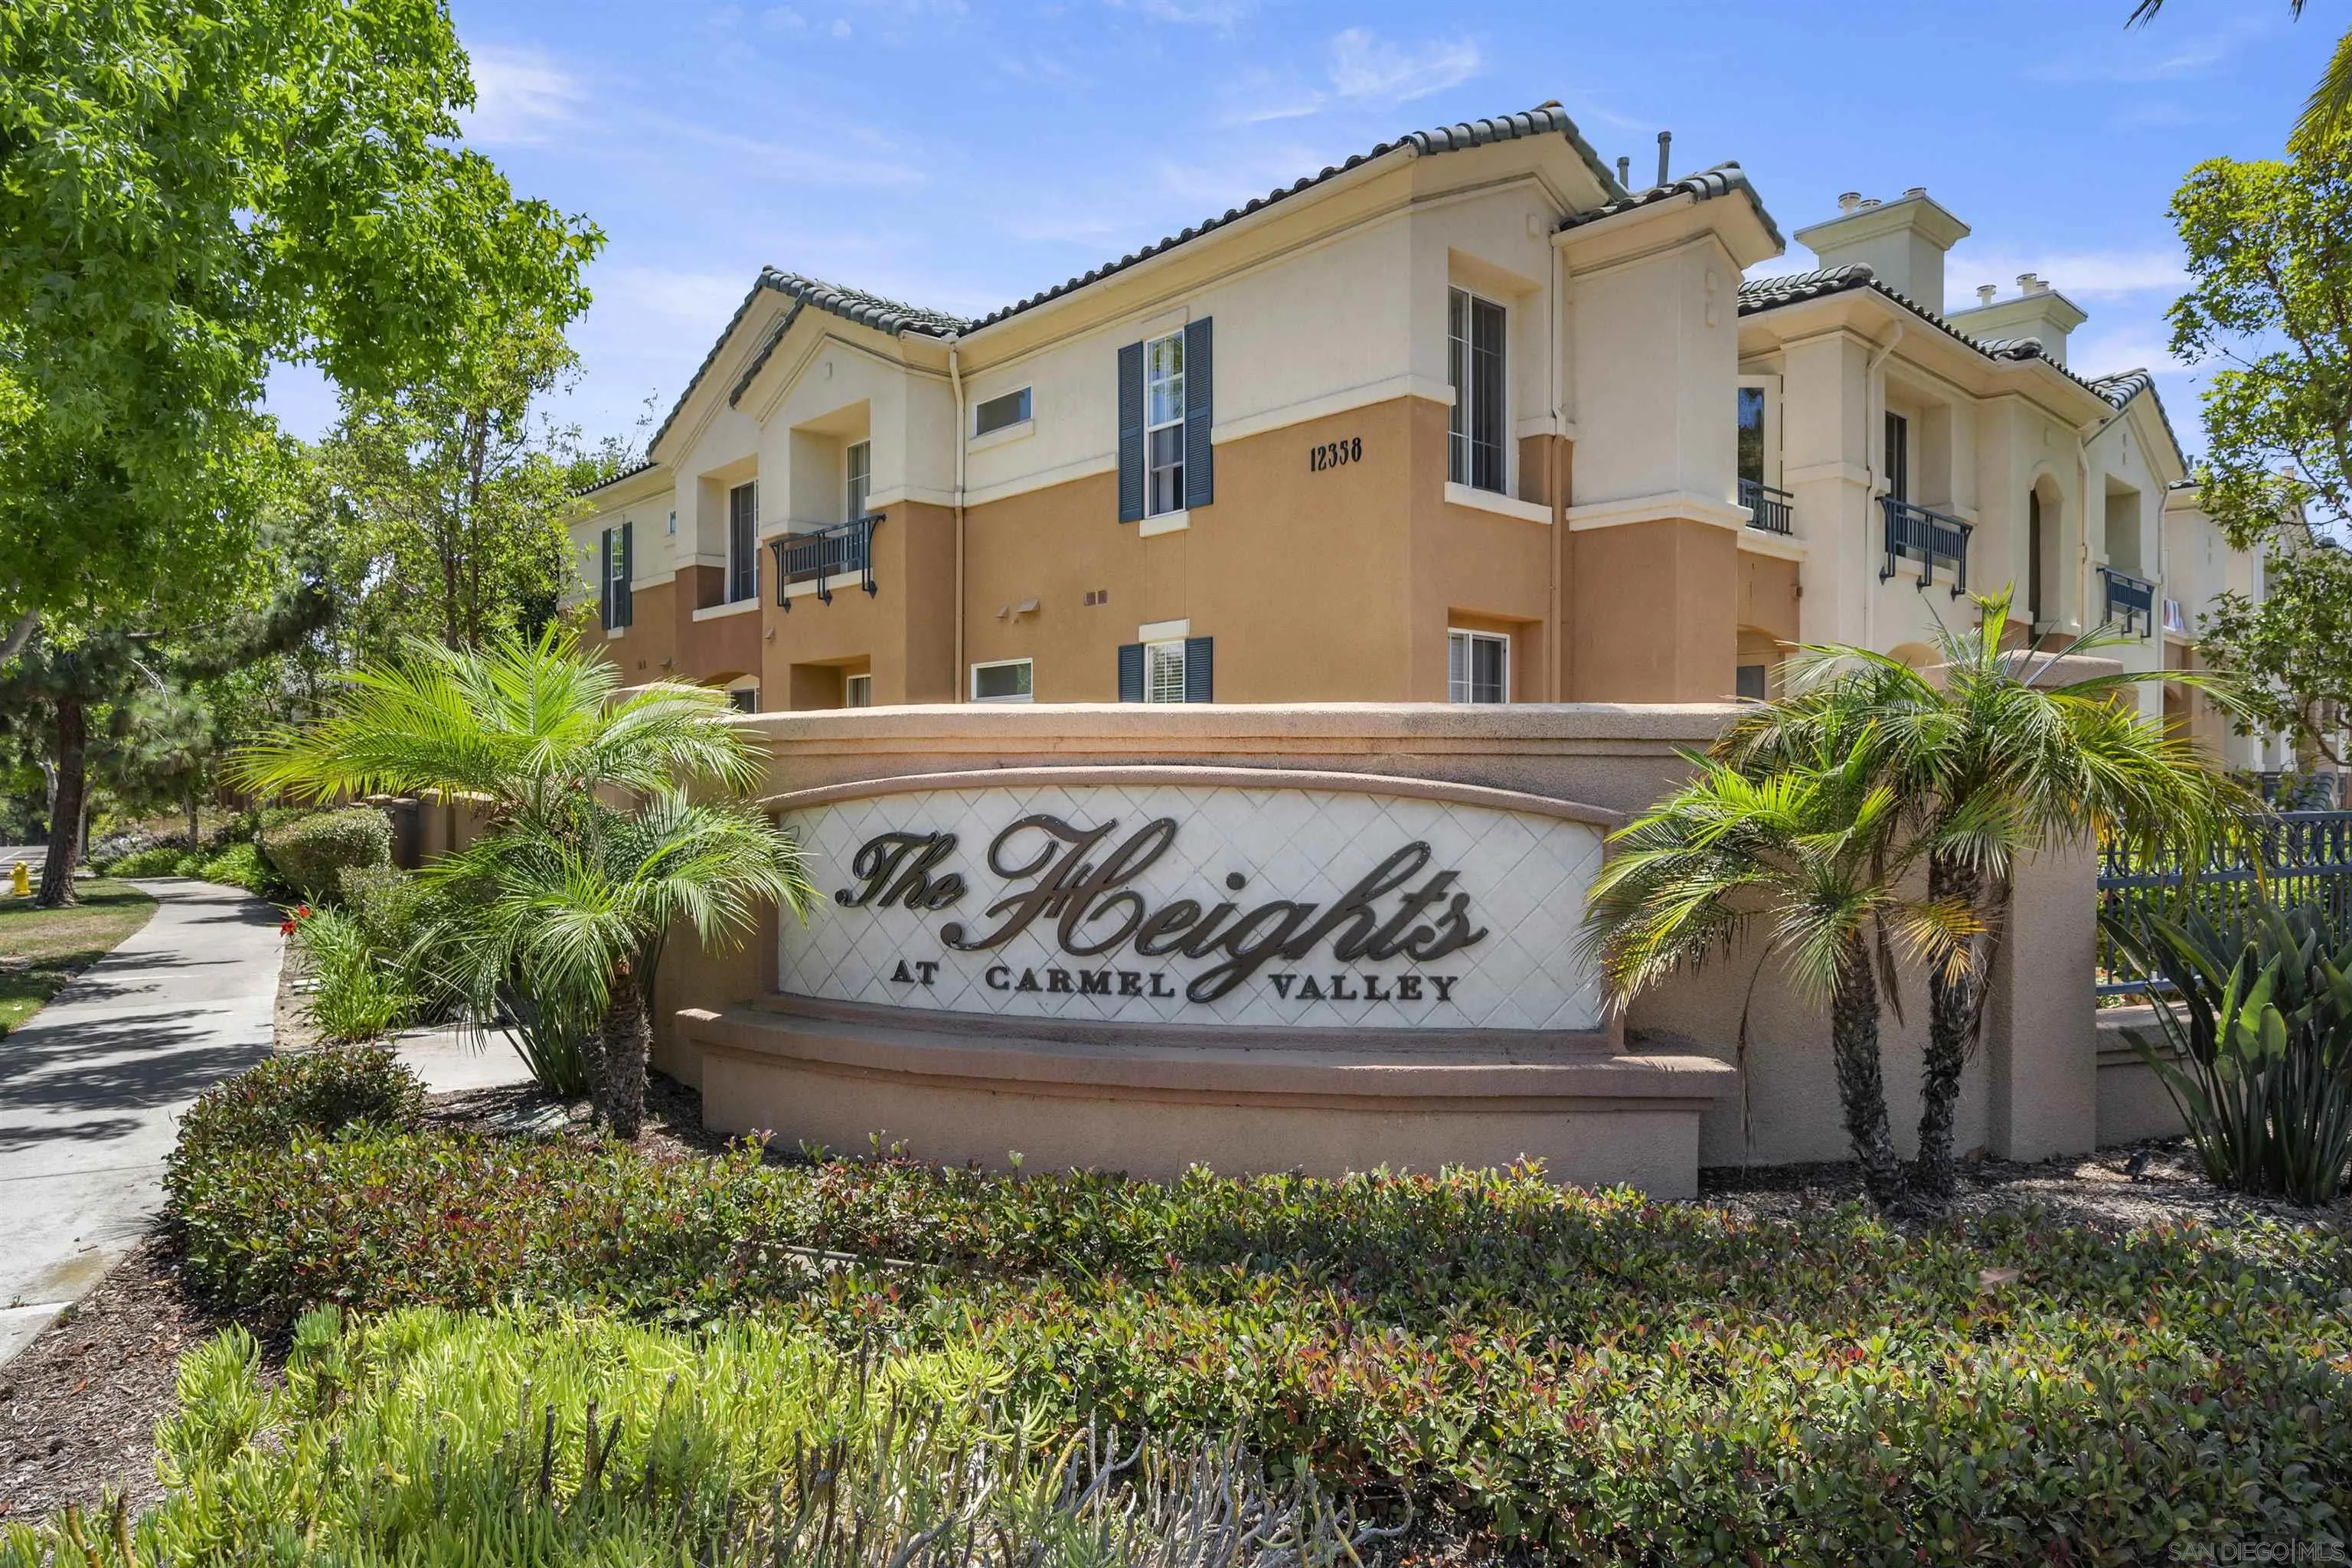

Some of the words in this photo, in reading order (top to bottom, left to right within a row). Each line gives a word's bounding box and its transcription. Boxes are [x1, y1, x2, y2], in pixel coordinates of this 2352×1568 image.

[1311, 437, 1361, 472] 12358
[835, 831, 967, 910] The
[940, 813, 1488, 1004] Heights
[890, 959, 940, 986] AT
[985, 965, 1176, 999] CARMEL
[1268, 973, 1459, 1001] VALLEY
